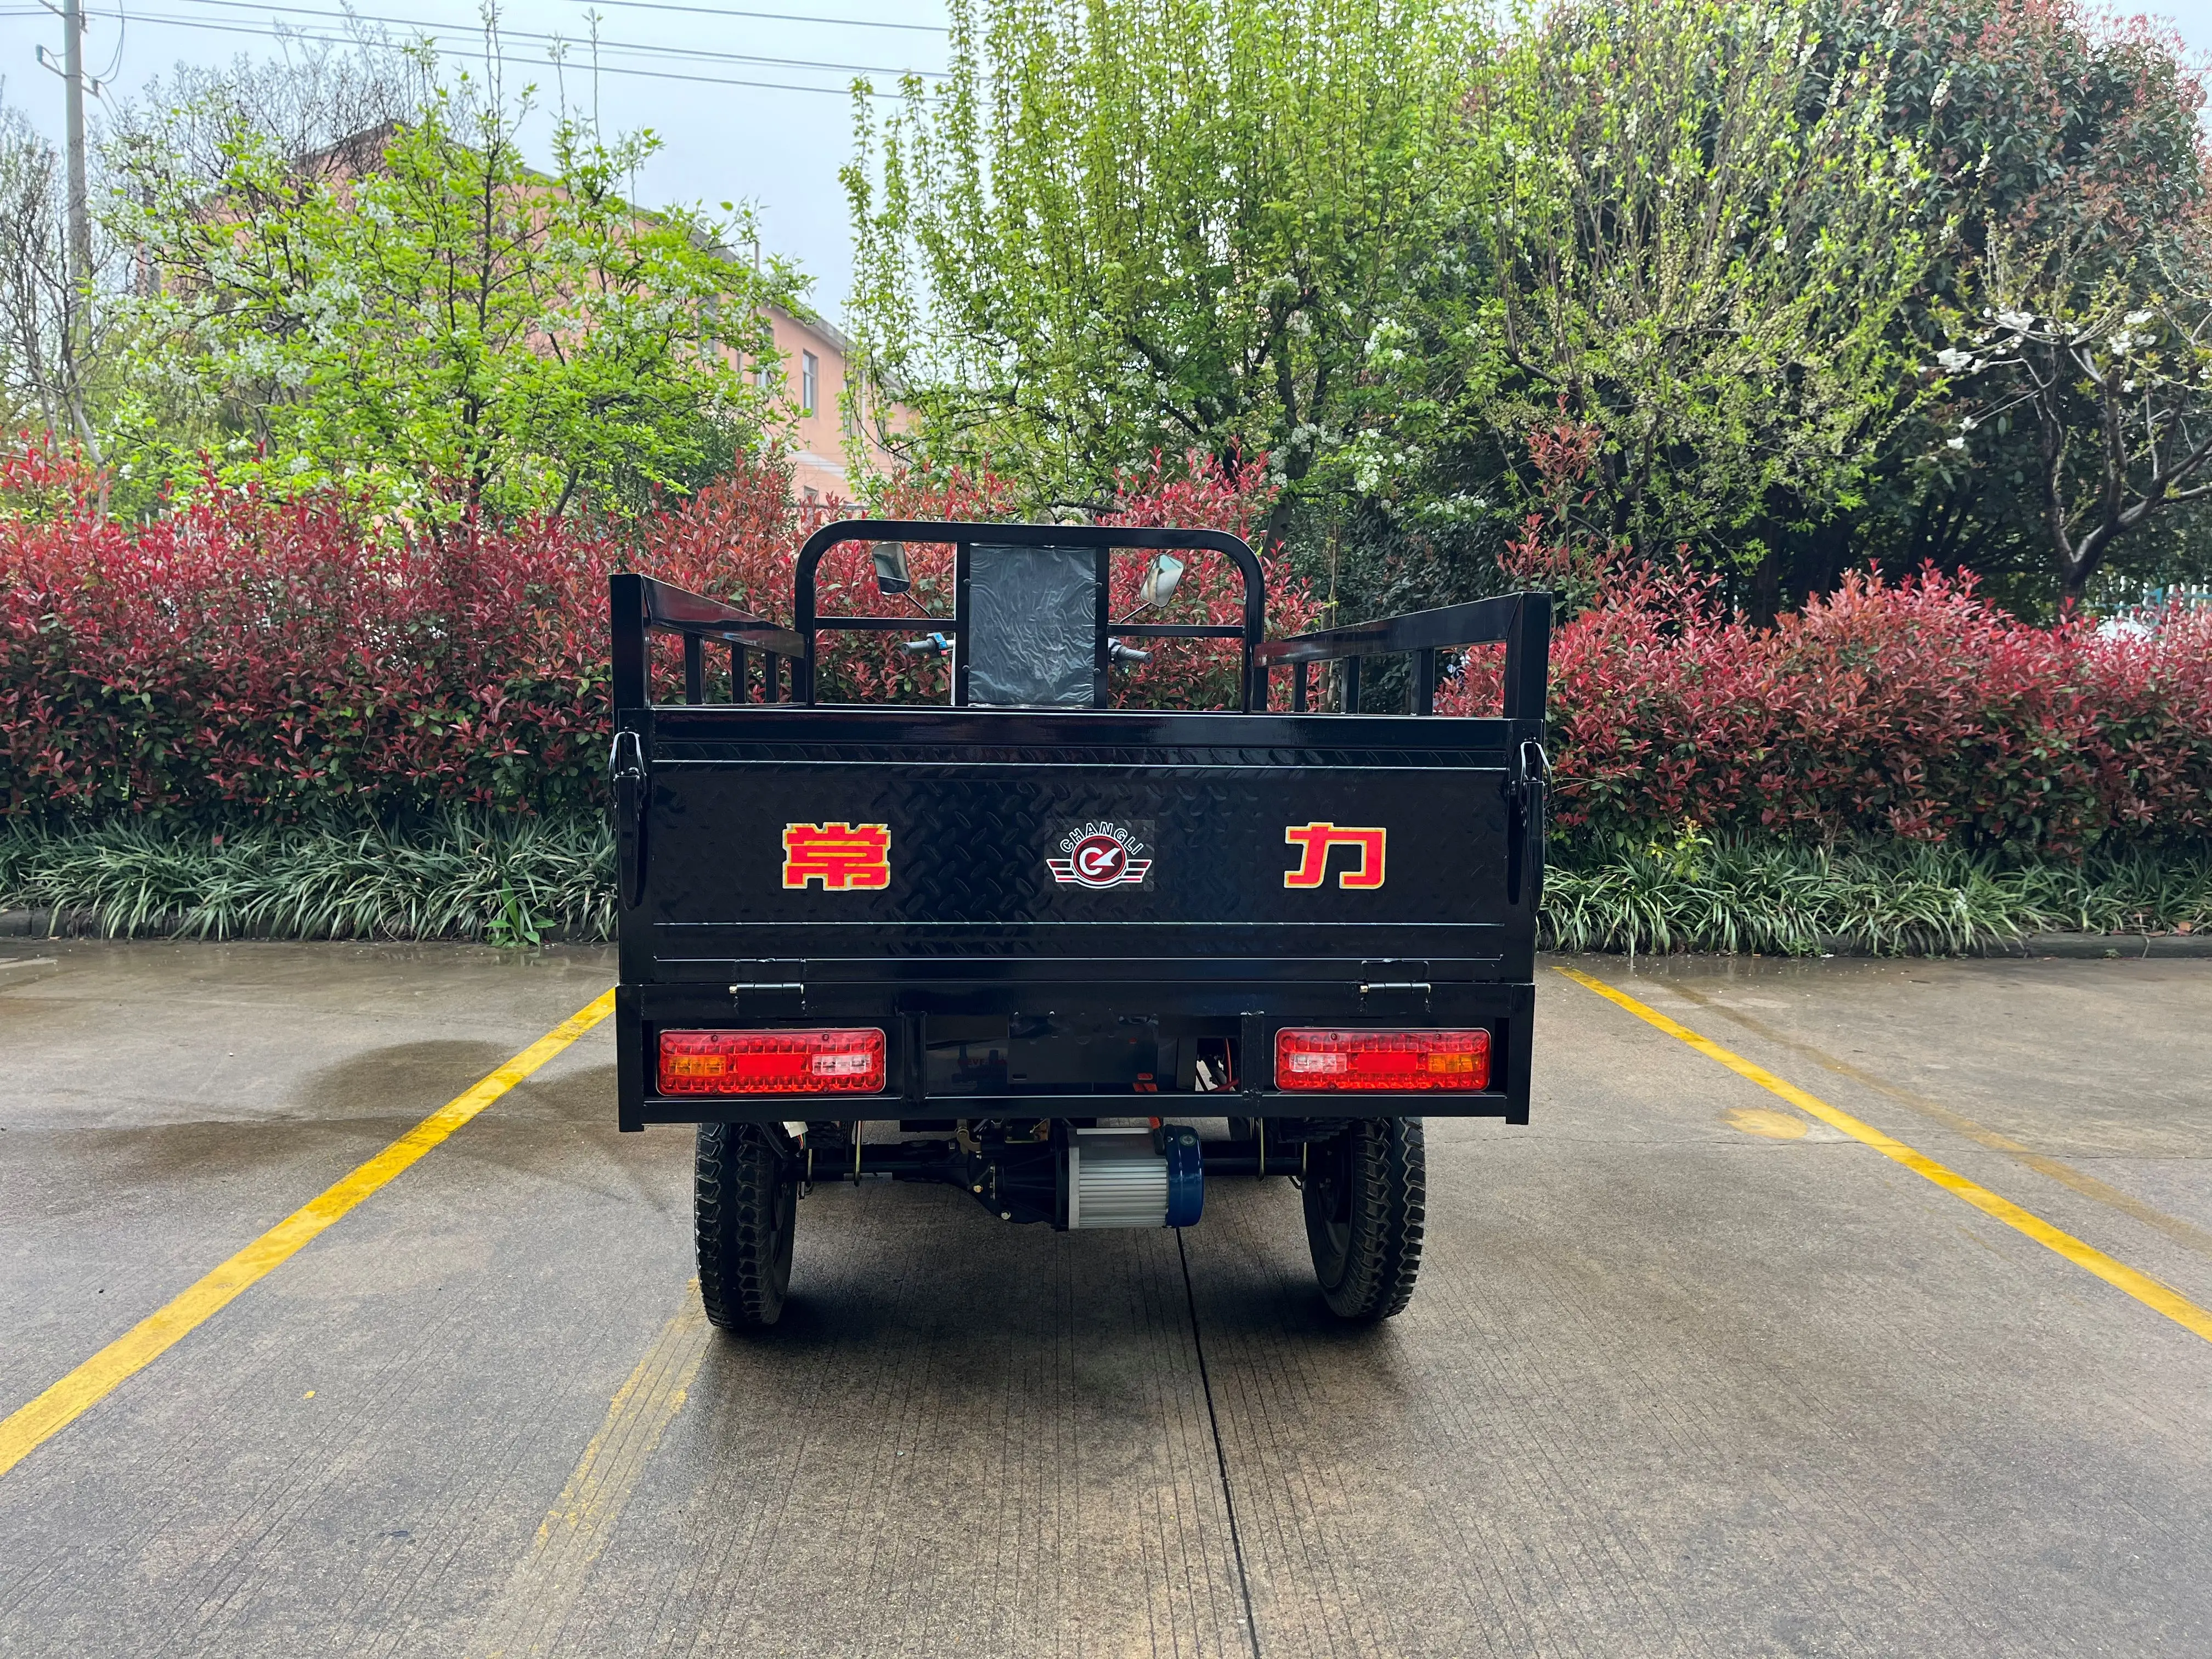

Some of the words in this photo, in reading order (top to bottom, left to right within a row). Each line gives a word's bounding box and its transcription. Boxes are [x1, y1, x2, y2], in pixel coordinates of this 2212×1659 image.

[782, 822, 891, 891] 常
[1284, 822, 1386, 889] 力
[1059, 821, 1144, 855] CHANGLI
